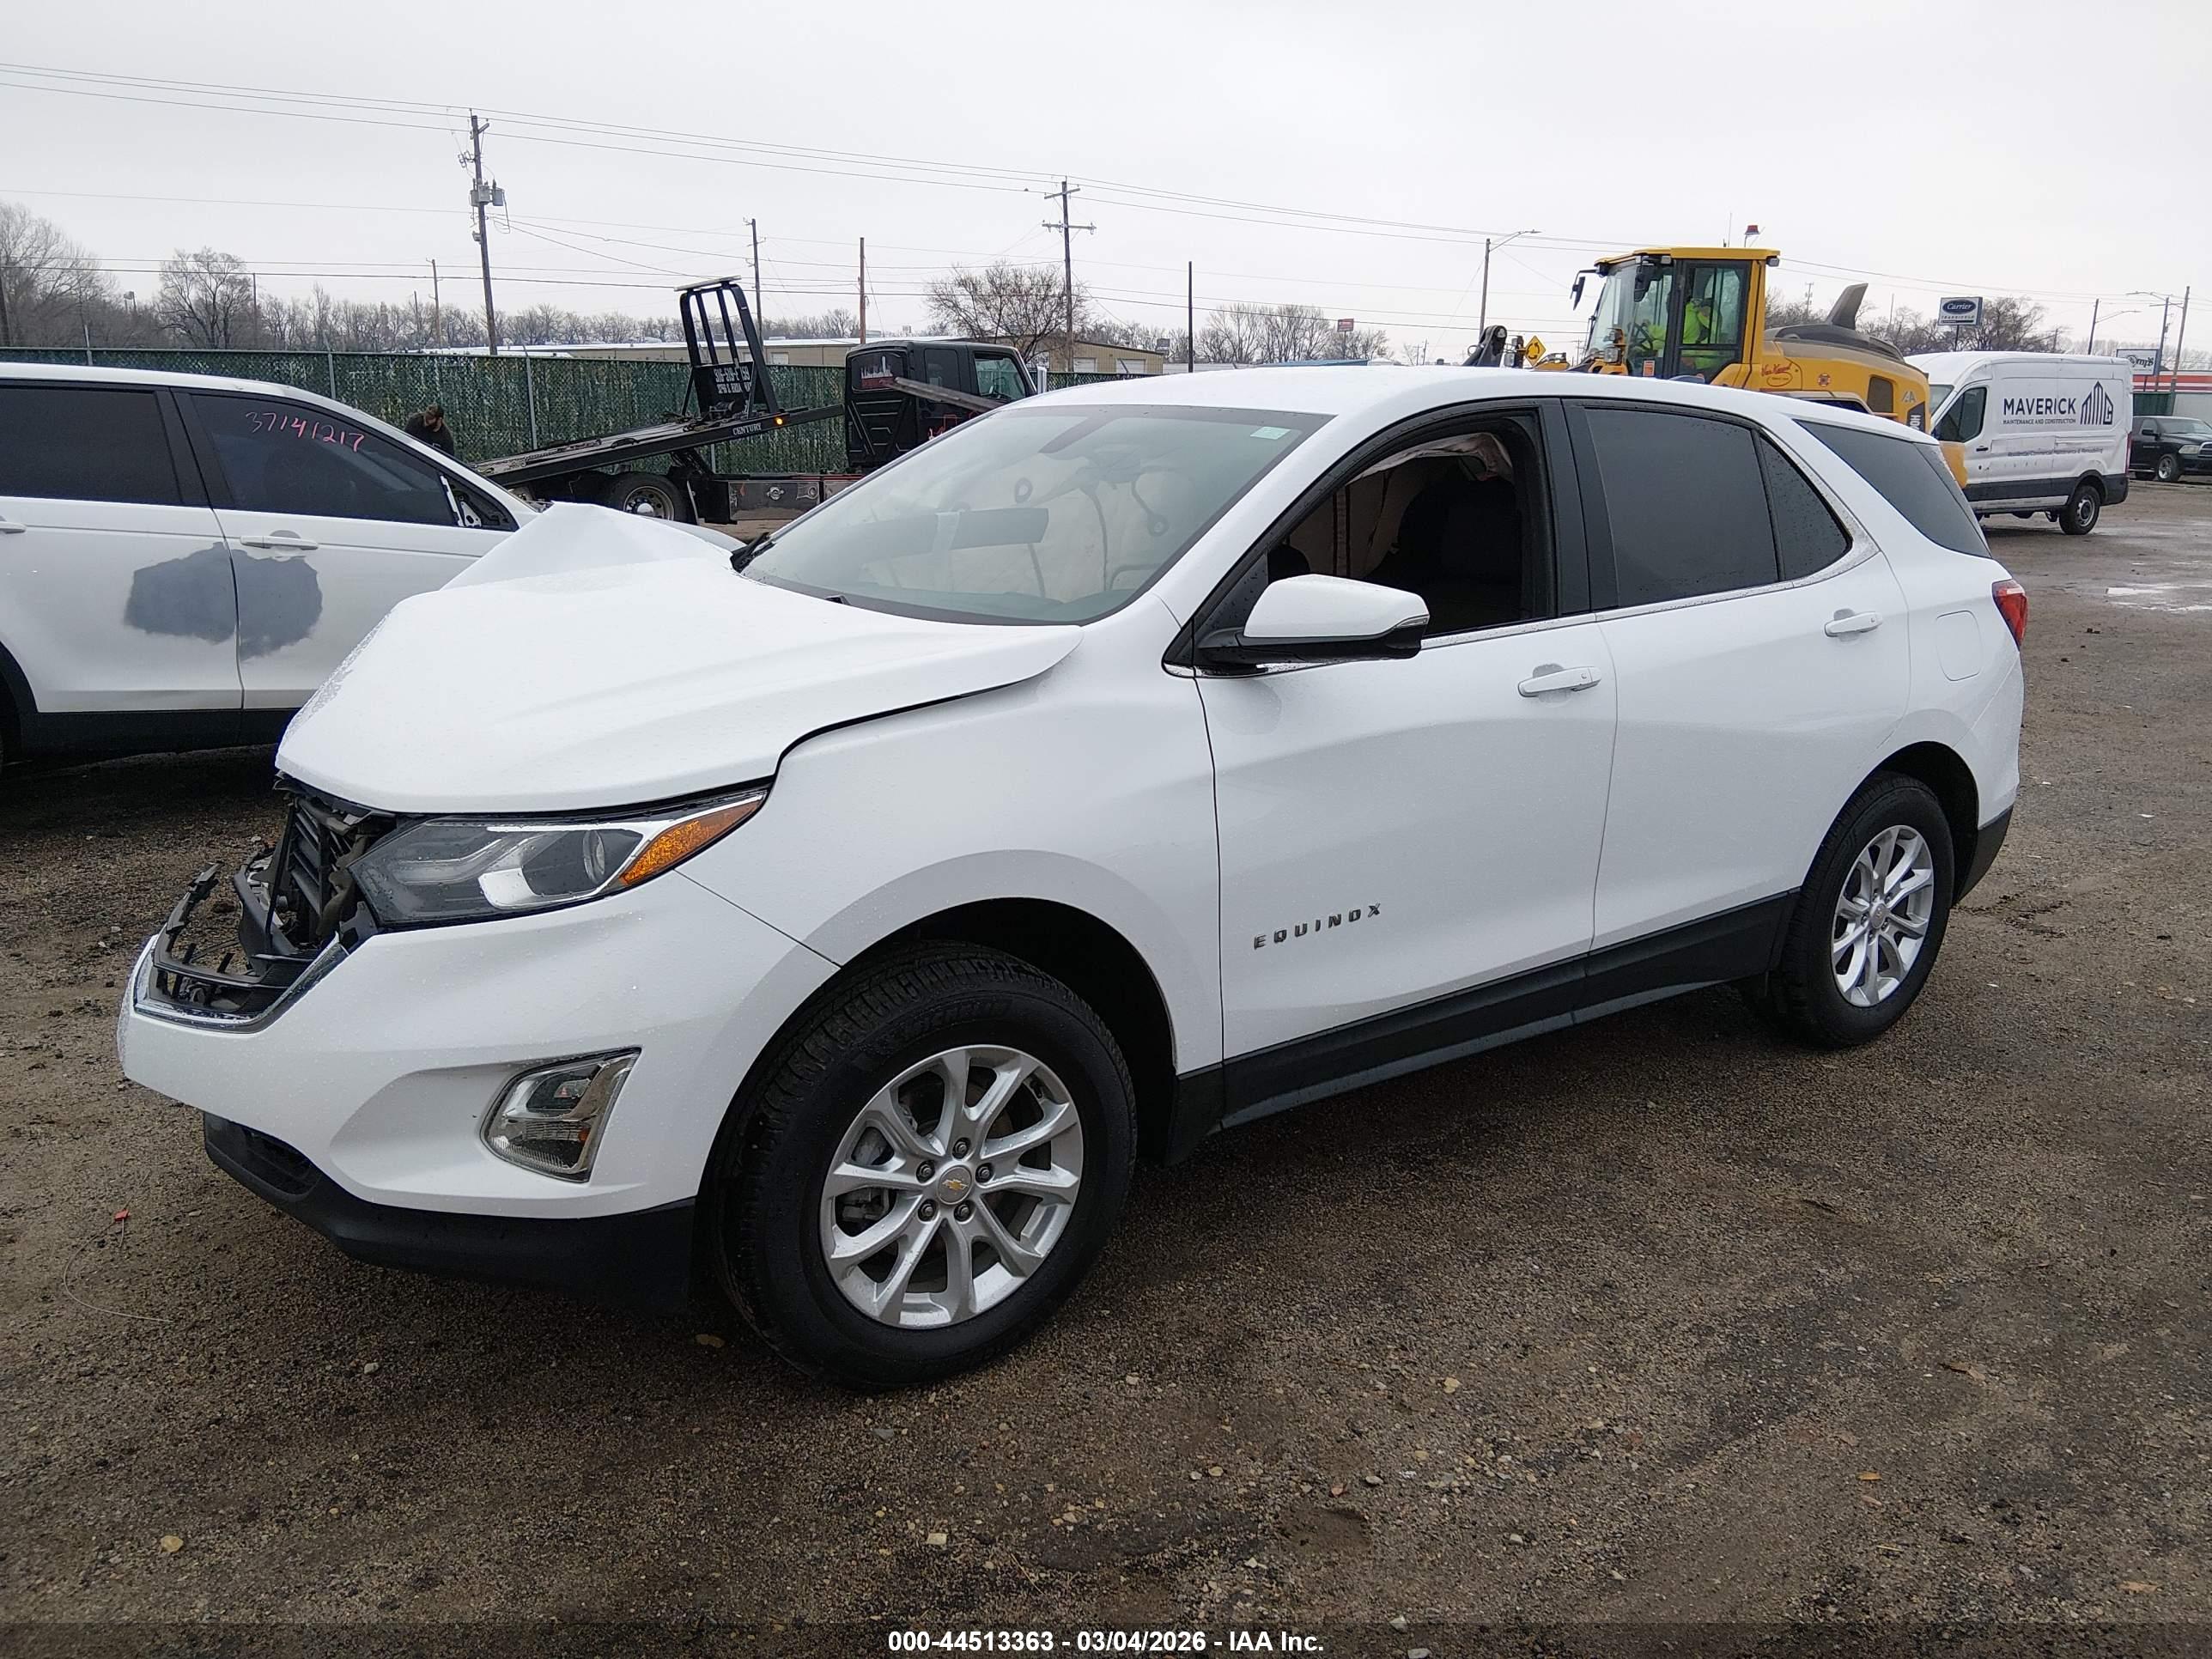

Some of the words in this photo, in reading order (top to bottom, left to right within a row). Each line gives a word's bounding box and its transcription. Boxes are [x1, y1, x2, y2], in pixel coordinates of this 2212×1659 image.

[2003, 398, 2076, 416] MAVERICK
[246, 411, 365, 453] 37141217
[732, 422, 762, 435] CENTURY
[1254, 902, 1381, 950] EQUINOX
